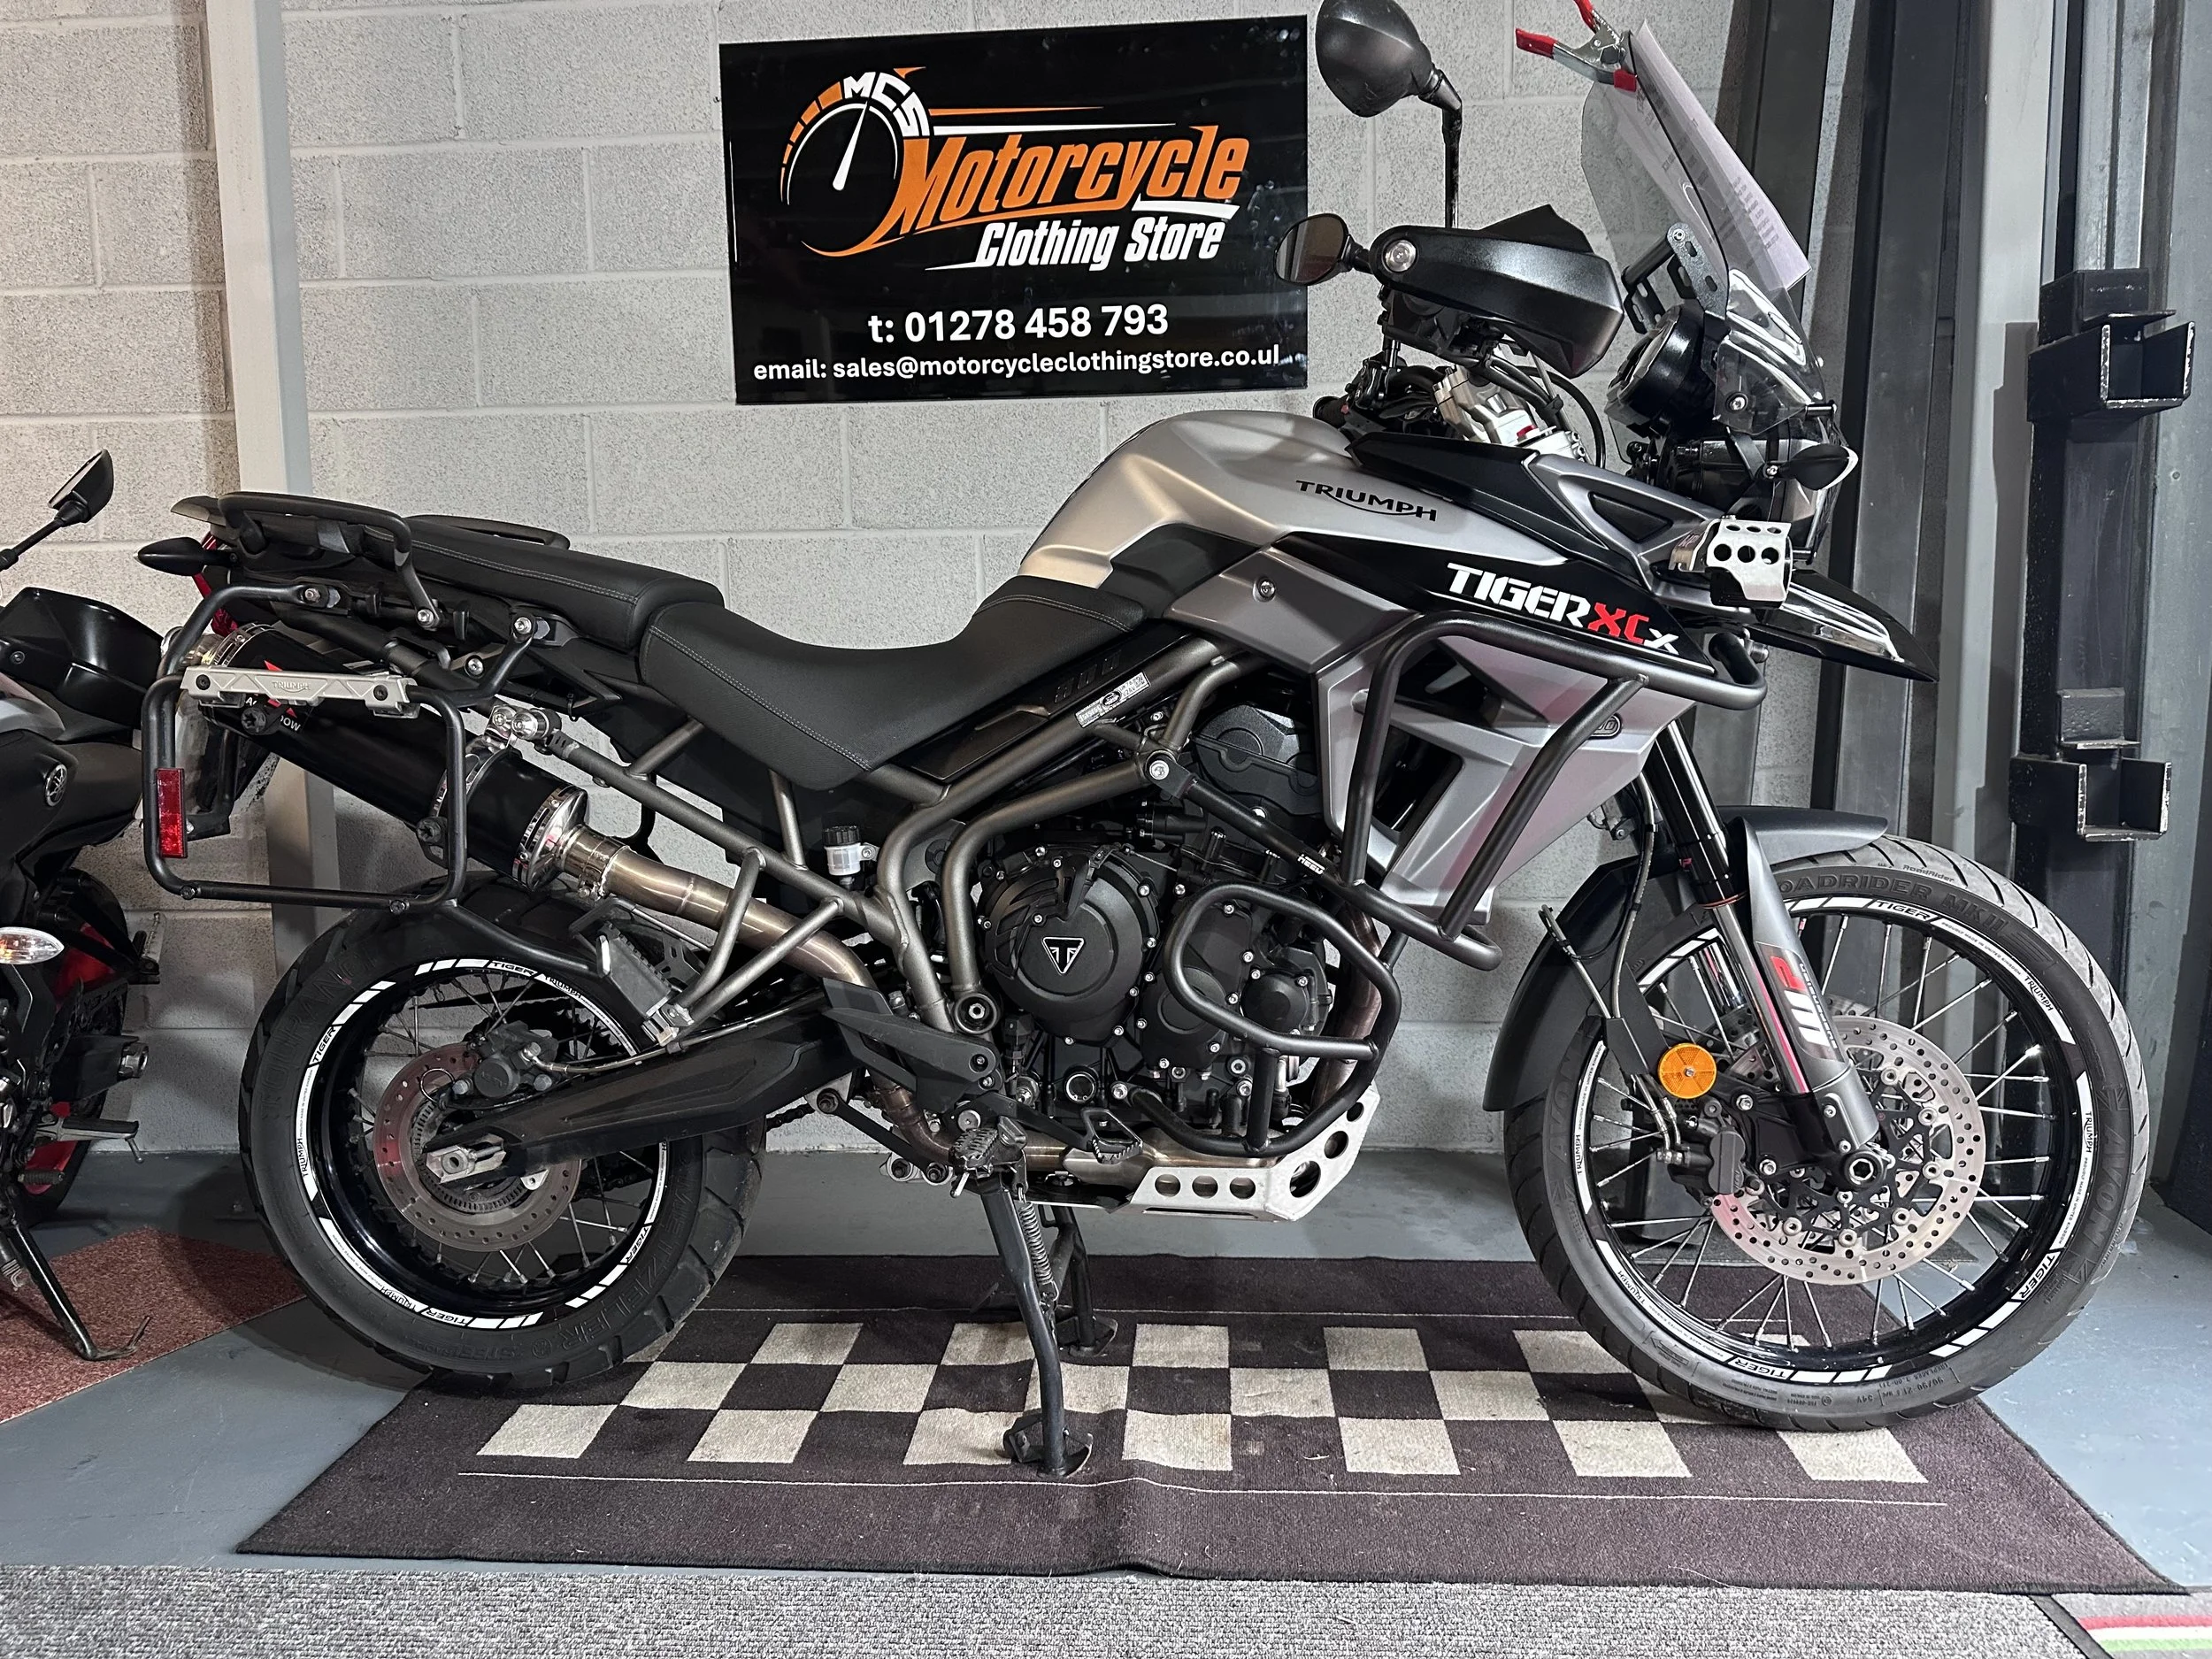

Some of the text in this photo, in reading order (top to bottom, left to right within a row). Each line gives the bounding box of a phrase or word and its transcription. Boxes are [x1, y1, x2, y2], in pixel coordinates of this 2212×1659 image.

[843, 72, 930, 136] MCS
[898, 126, 1248, 235] Motorcycle
[976, 215, 1226, 272] Clothing Store
[867, 303, 1169, 343] t: 01278 458 793
[753, 358, 827, 380] email:
[1296, 480, 1437, 522] TRIUMPH
[1447, 563, 1592, 628] TIGER
[1778, 873, 1933, 901] OADRIDER
[1876, 900, 1931, 920] TIGER
[492, 962, 535, 976] TIGER
[2024, 975, 2055, 1011] TRIUMPH
[312, 1026, 336, 1063] TIGER
[2083, 1110, 2093, 1154] TRIUMPH
[296, 1137, 309, 1178] TRIUMPH
[1575, 1133, 1585, 1176] TRIUMPH
[2082, 1124, 2126, 1248] AVON
[626, 1226, 649, 1263] TIGER
[1617, 1270, 1646, 1307] TRIUMPH
[2018, 1253, 2057, 1300] TIGER
[380, 1286, 419, 1313] TRIUMPH
[426, 1307, 469, 1325] TIGER
[1734, 1358, 1787, 1379] TIGER
